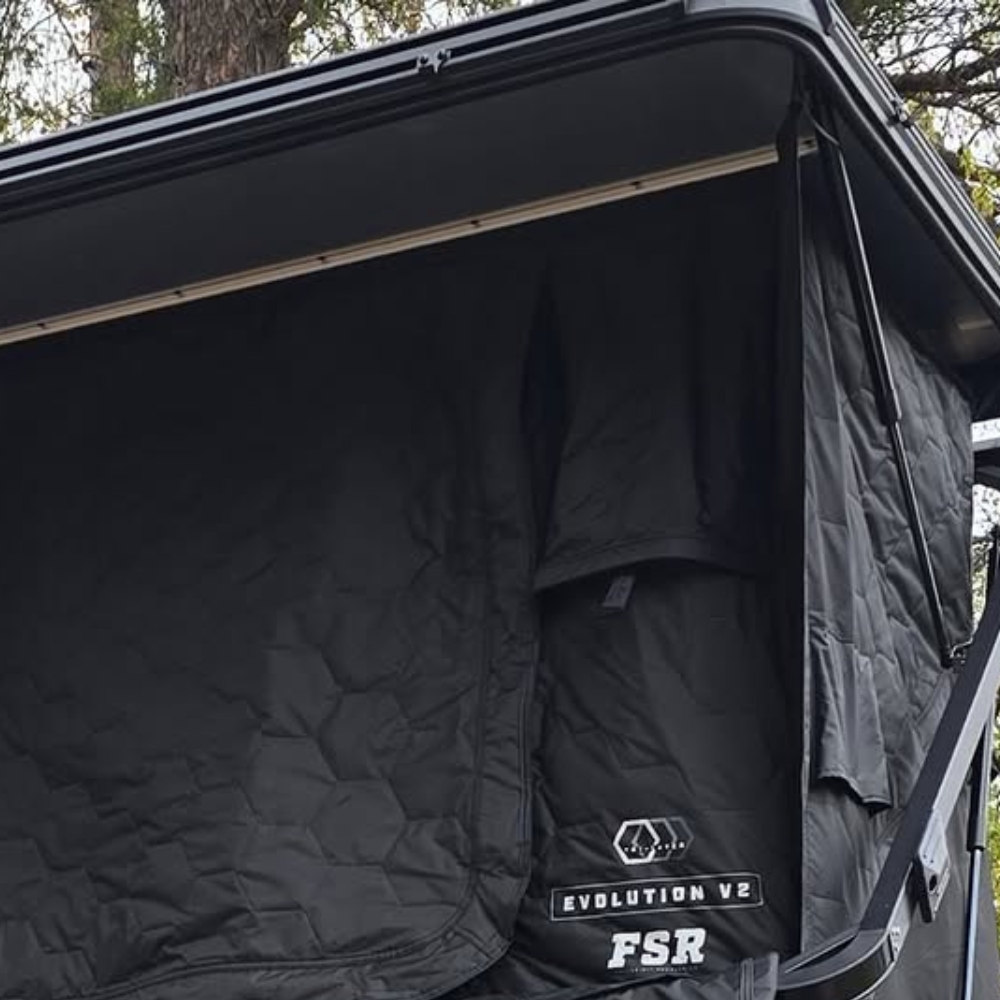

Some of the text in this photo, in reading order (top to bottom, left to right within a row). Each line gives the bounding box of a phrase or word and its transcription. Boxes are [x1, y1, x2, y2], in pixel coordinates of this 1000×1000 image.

[563, 882, 750, 912] EVOLUTION V2
[607, 927, 706, 969] FSR
